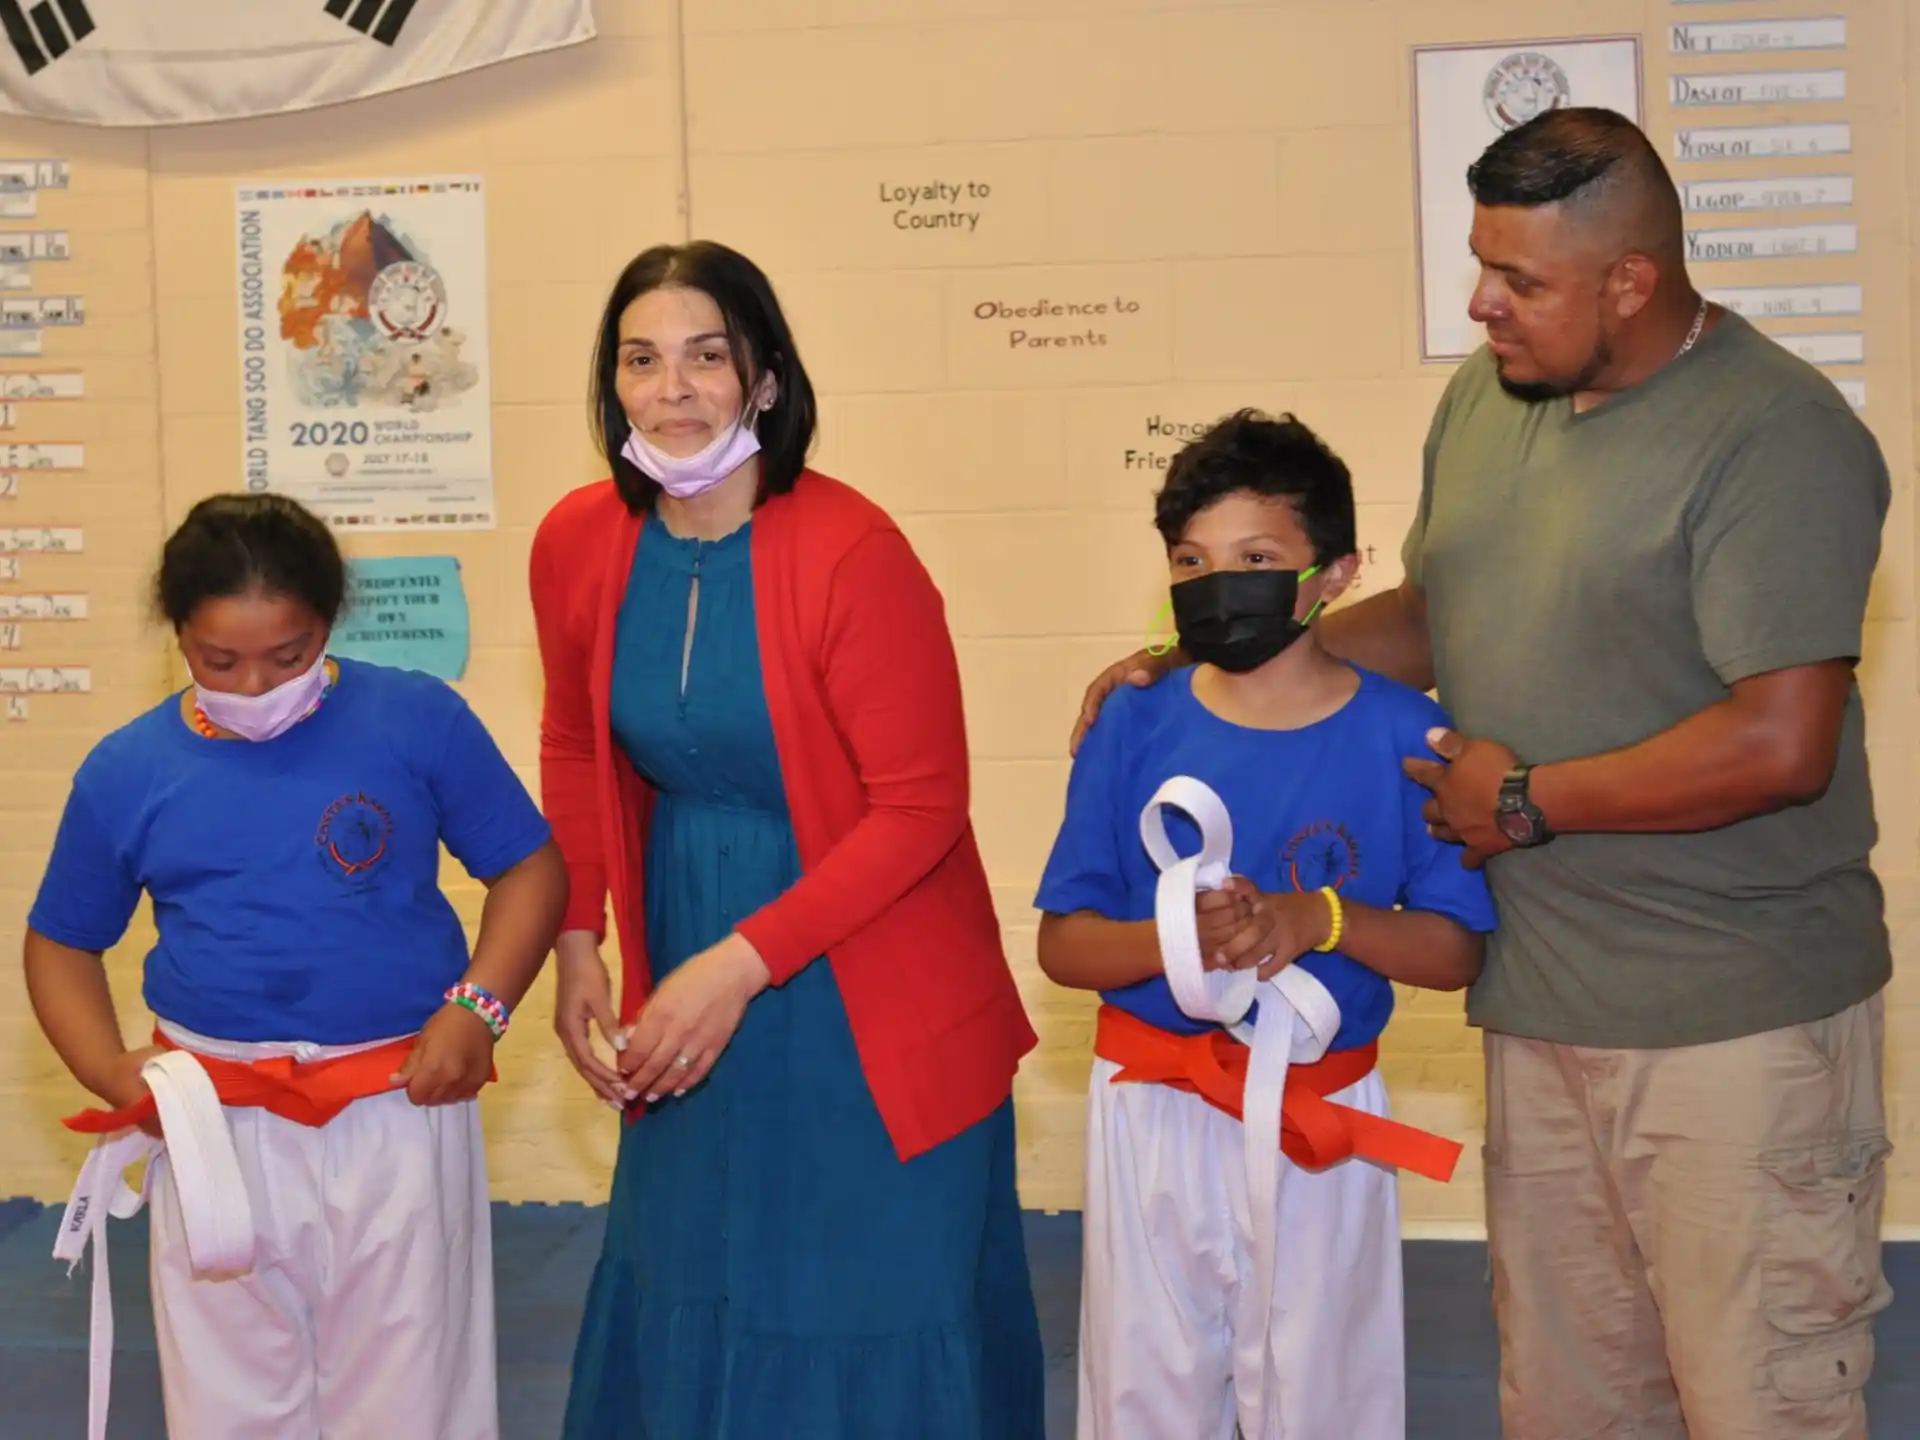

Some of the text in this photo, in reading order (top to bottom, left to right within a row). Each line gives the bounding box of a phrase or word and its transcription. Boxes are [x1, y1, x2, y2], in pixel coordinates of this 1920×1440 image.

[879, 179, 990, 205] Loyalty to
[893, 209, 980, 232] Country
[974, 296, 1140, 319] Obedience to
[240, 209, 269, 491] ORLD TANG SOO DO ASSOCIATION
[1009, 328, 1107, 349] Parents
[290, 421, 368, 446] 2020
[373, 431, 472, 445] CHAMPIONSHIP
[1125, 450, 1170, 470] Frie
